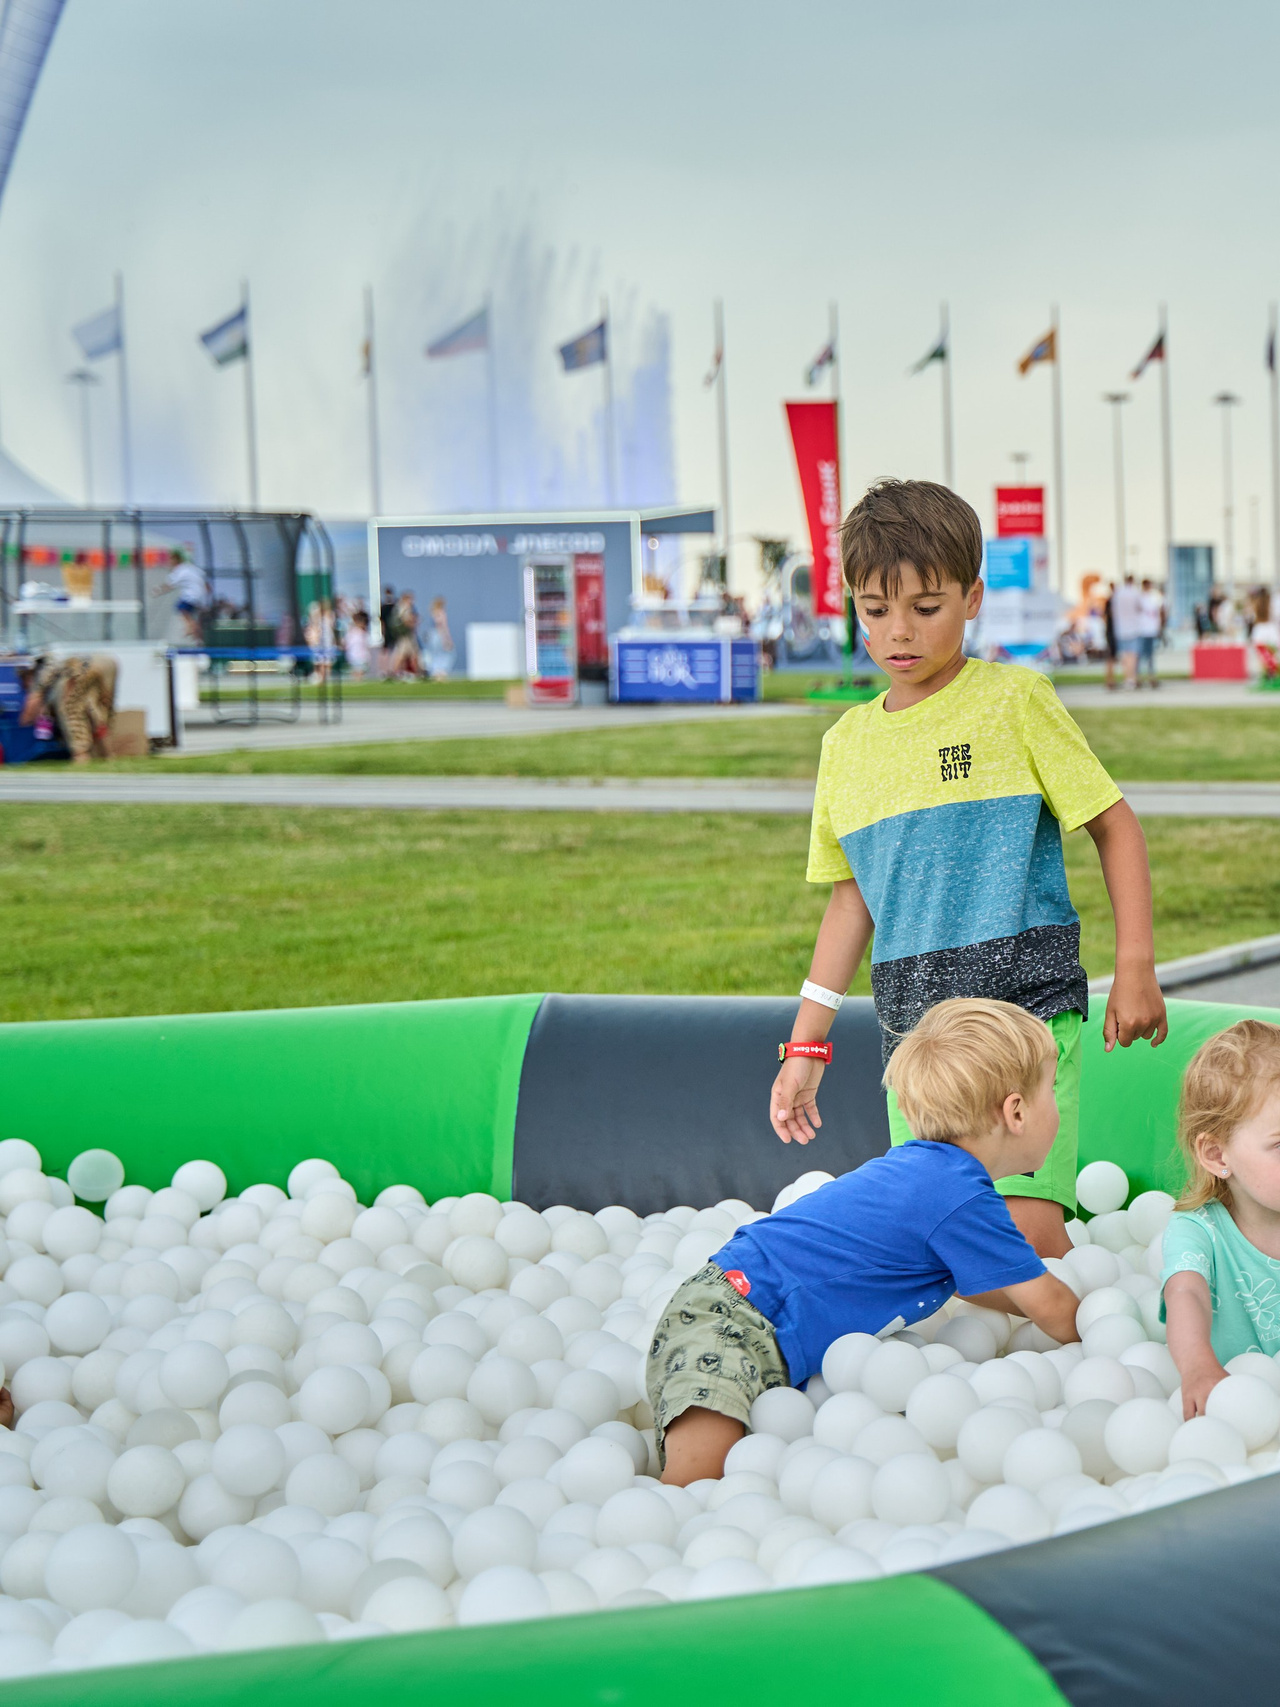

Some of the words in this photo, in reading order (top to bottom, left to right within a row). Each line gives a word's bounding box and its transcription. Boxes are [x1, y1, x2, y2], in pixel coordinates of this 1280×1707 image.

[401, 534, 498, 557] OMODA
[938, 743, 972, 764] TER
[940, 761, 972, 782] MIT
